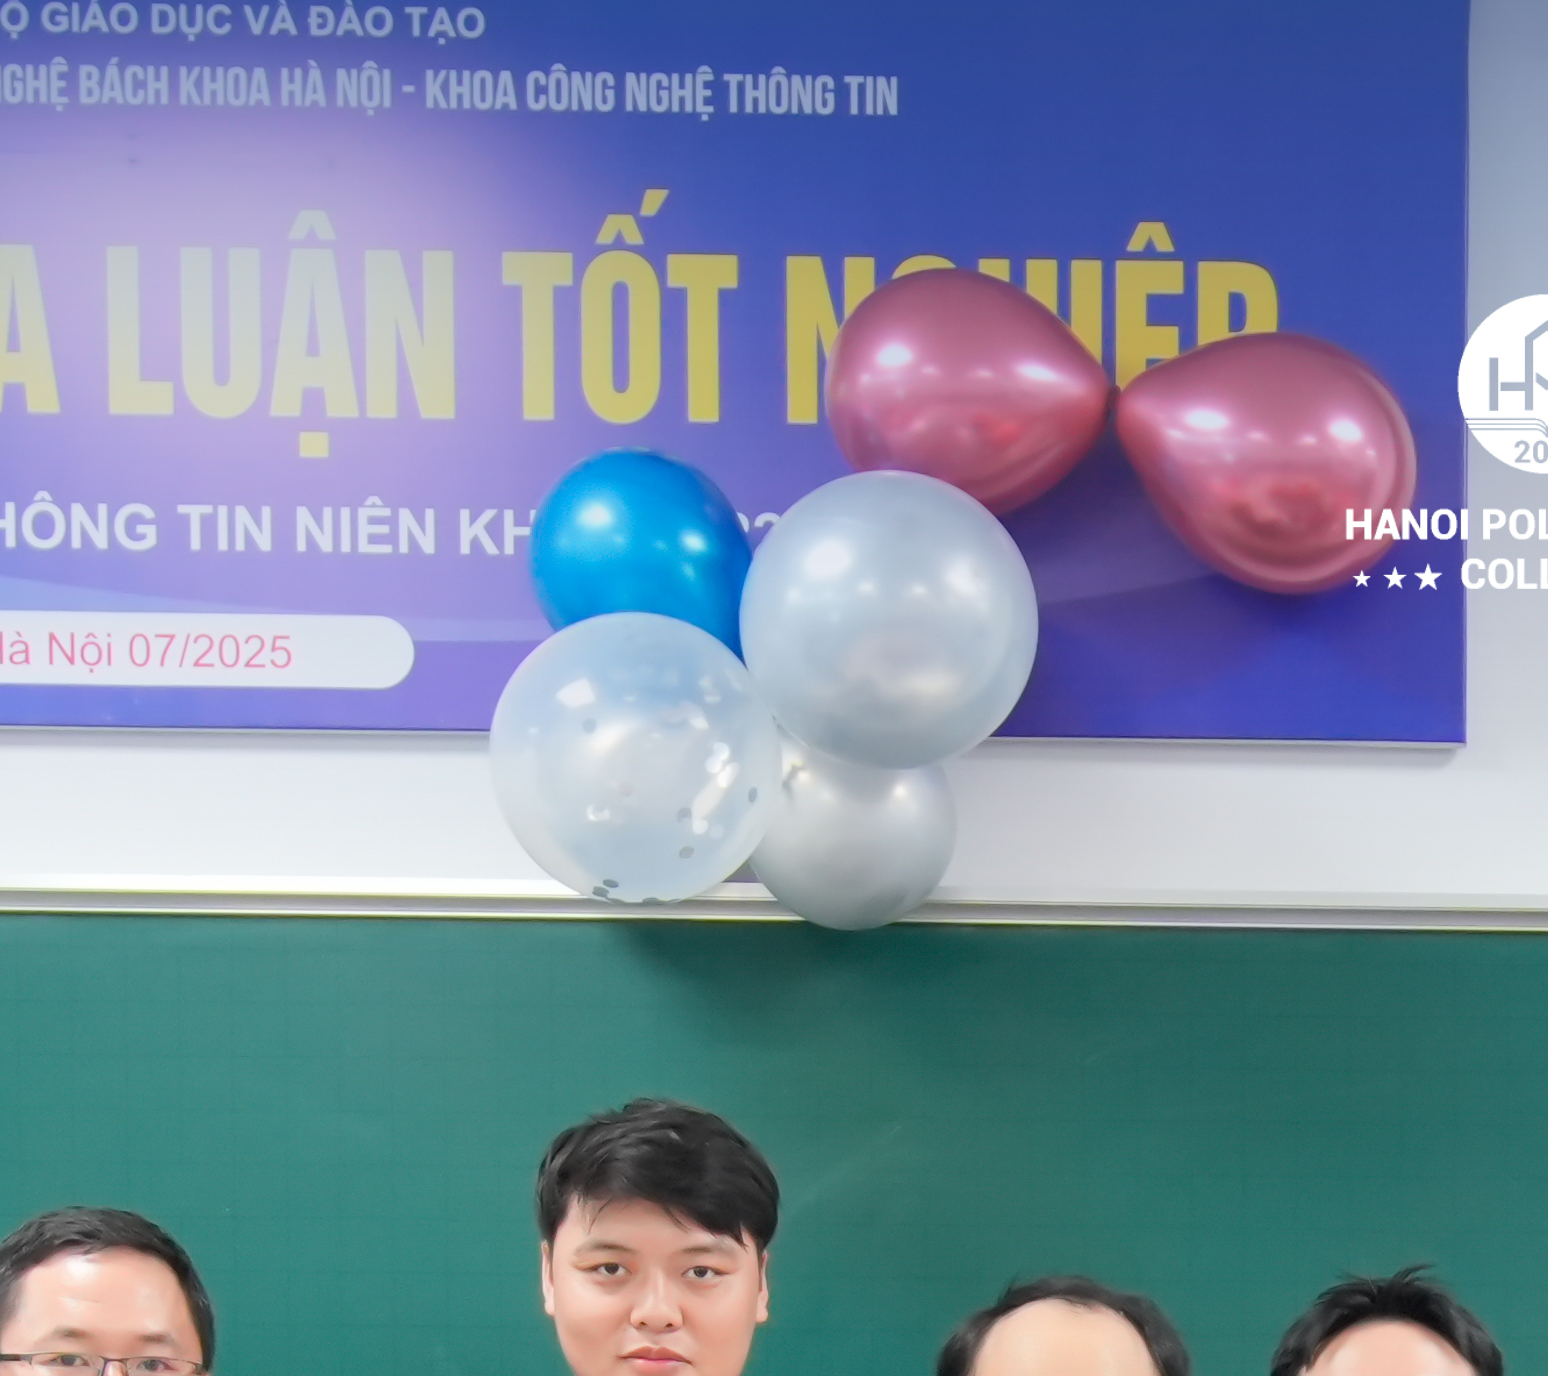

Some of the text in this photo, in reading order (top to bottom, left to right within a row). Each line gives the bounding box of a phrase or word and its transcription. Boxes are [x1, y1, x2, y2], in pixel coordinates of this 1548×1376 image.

[40, 0, 138, 34] GIÁO
[151, 0, 232, 42] DỤC
[245, 0, 298, 36] VÀ
[308, 0, 393, 38] ĐÀO
[413, 6, 485, 44] TẠO
[79, 57, 168, 105] BÁCH
[179, 66, 270, 107] KHOA
[281, 60, 326, 107] HÀ
[336, 60, 391, 116] NỘI
[426, 69, 517, 110] KHOA
[526, 63, 615, 113] CÔNG
[625, 65, 713, 121] NGHỆ
[724, 66, 835, 115] THÔNG
[843, 75, 898, 116] TIN
[107, 208, 455, 457] LUẬN
[502, 188, 738, 425] TỐT
[177, 504, 271, 551] TIN
[297, 496, 435, 555] NIÊN
[48, 631, 112, 674] Nội
[129, 633, 291, 670] 07/2025
